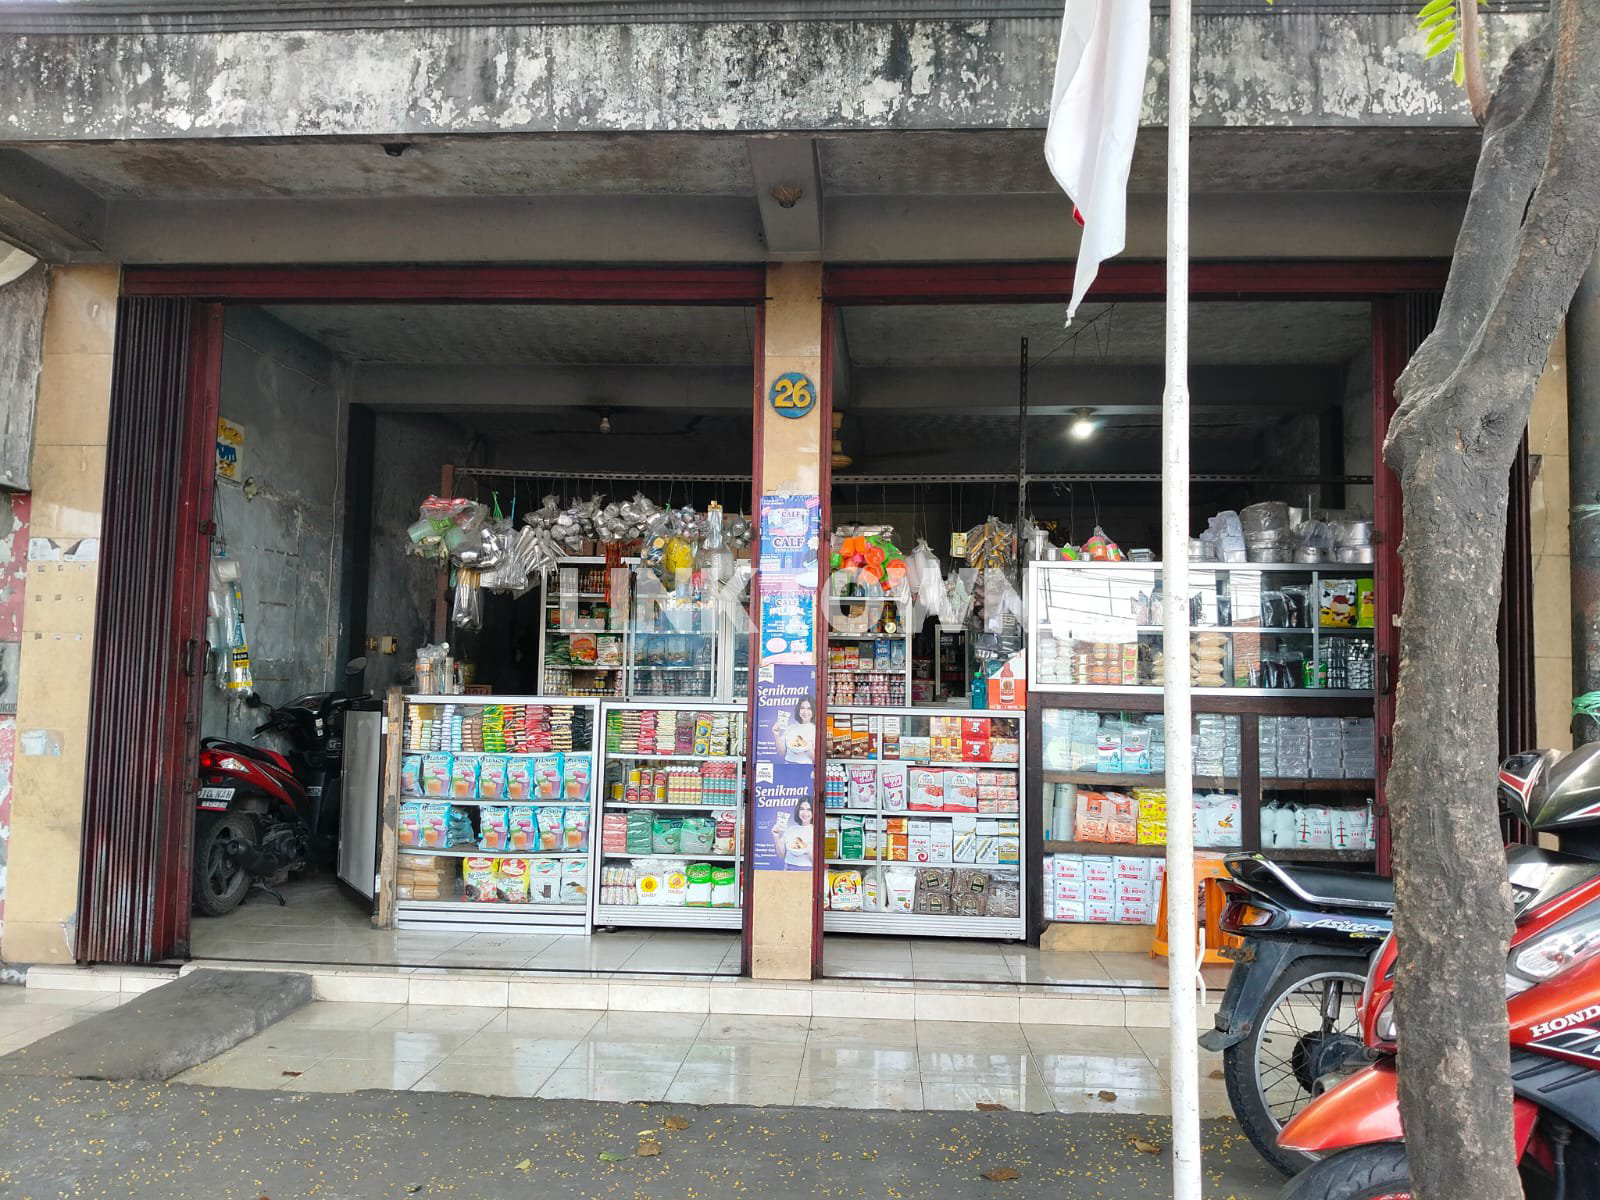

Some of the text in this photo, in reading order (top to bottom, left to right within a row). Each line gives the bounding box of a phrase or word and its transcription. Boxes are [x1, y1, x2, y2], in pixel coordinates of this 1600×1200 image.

[775, 379, 811, 408] 26
[773, 537, 804, 547] CALF
[758, 684, 809, 697] Senikmat
[758, 696, 800, 707] Santan
[755, 784, 809, 797] Senikmat
[757, 796, 799, 808] Santan
